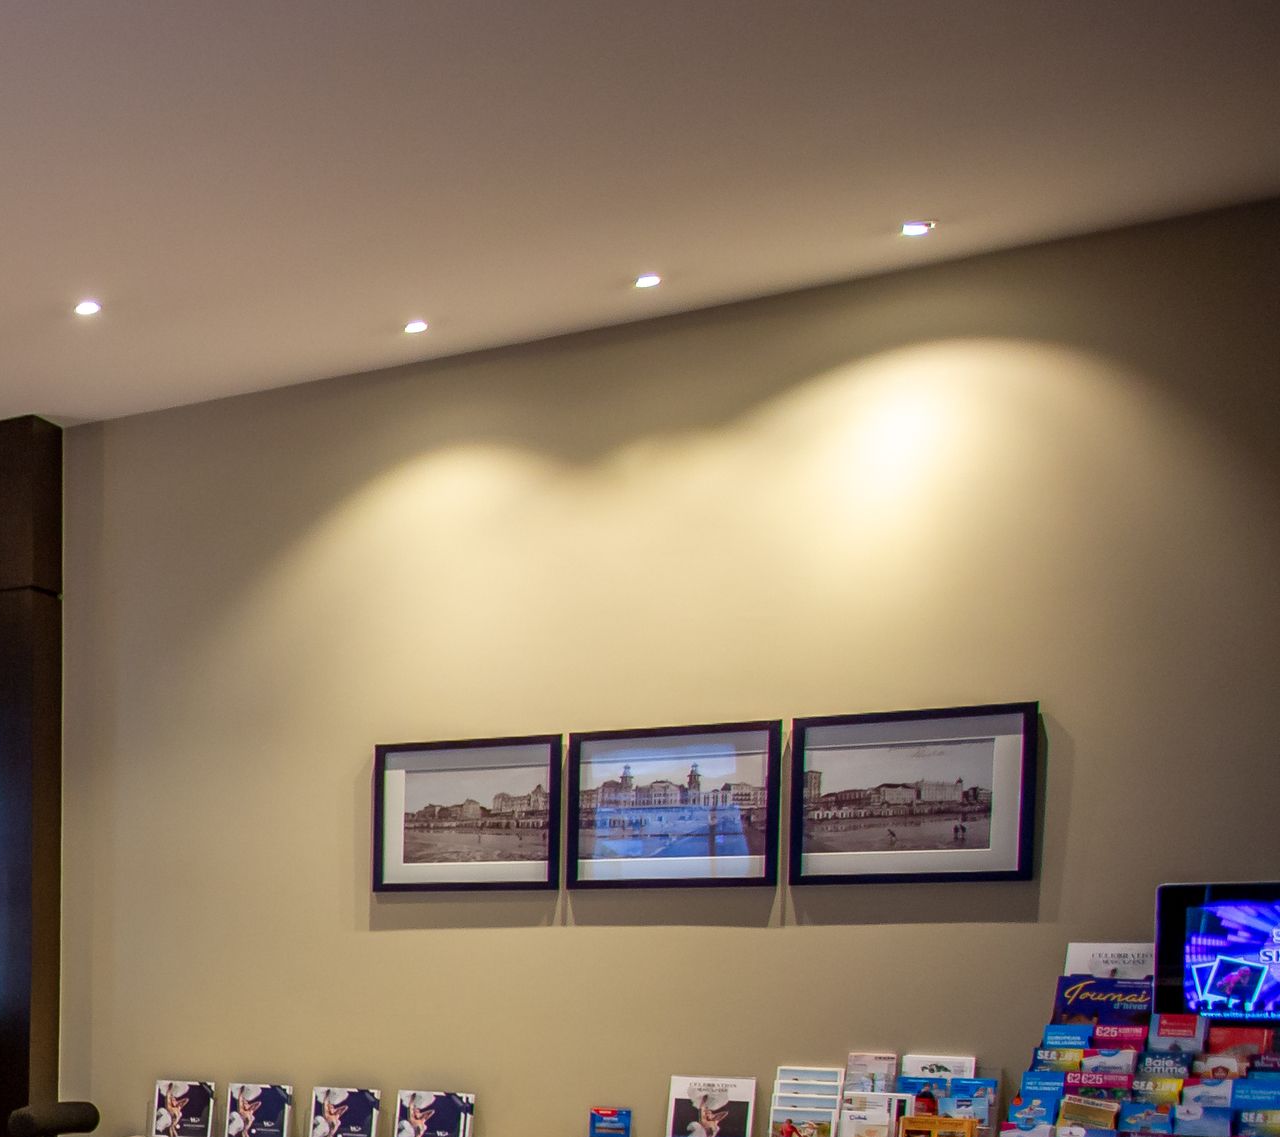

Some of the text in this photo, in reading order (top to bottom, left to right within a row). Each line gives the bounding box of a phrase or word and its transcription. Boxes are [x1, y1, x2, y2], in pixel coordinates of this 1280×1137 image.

[1063, 980, 1151, 1006] Tournai
[1037, 1049, 1057, 1060] SEA
[1145, 1057, 1174, 1067] Baie
[1132, 1080, 1153, 1091] SEA
[1241, 1111, 1264, 1123] SEA
